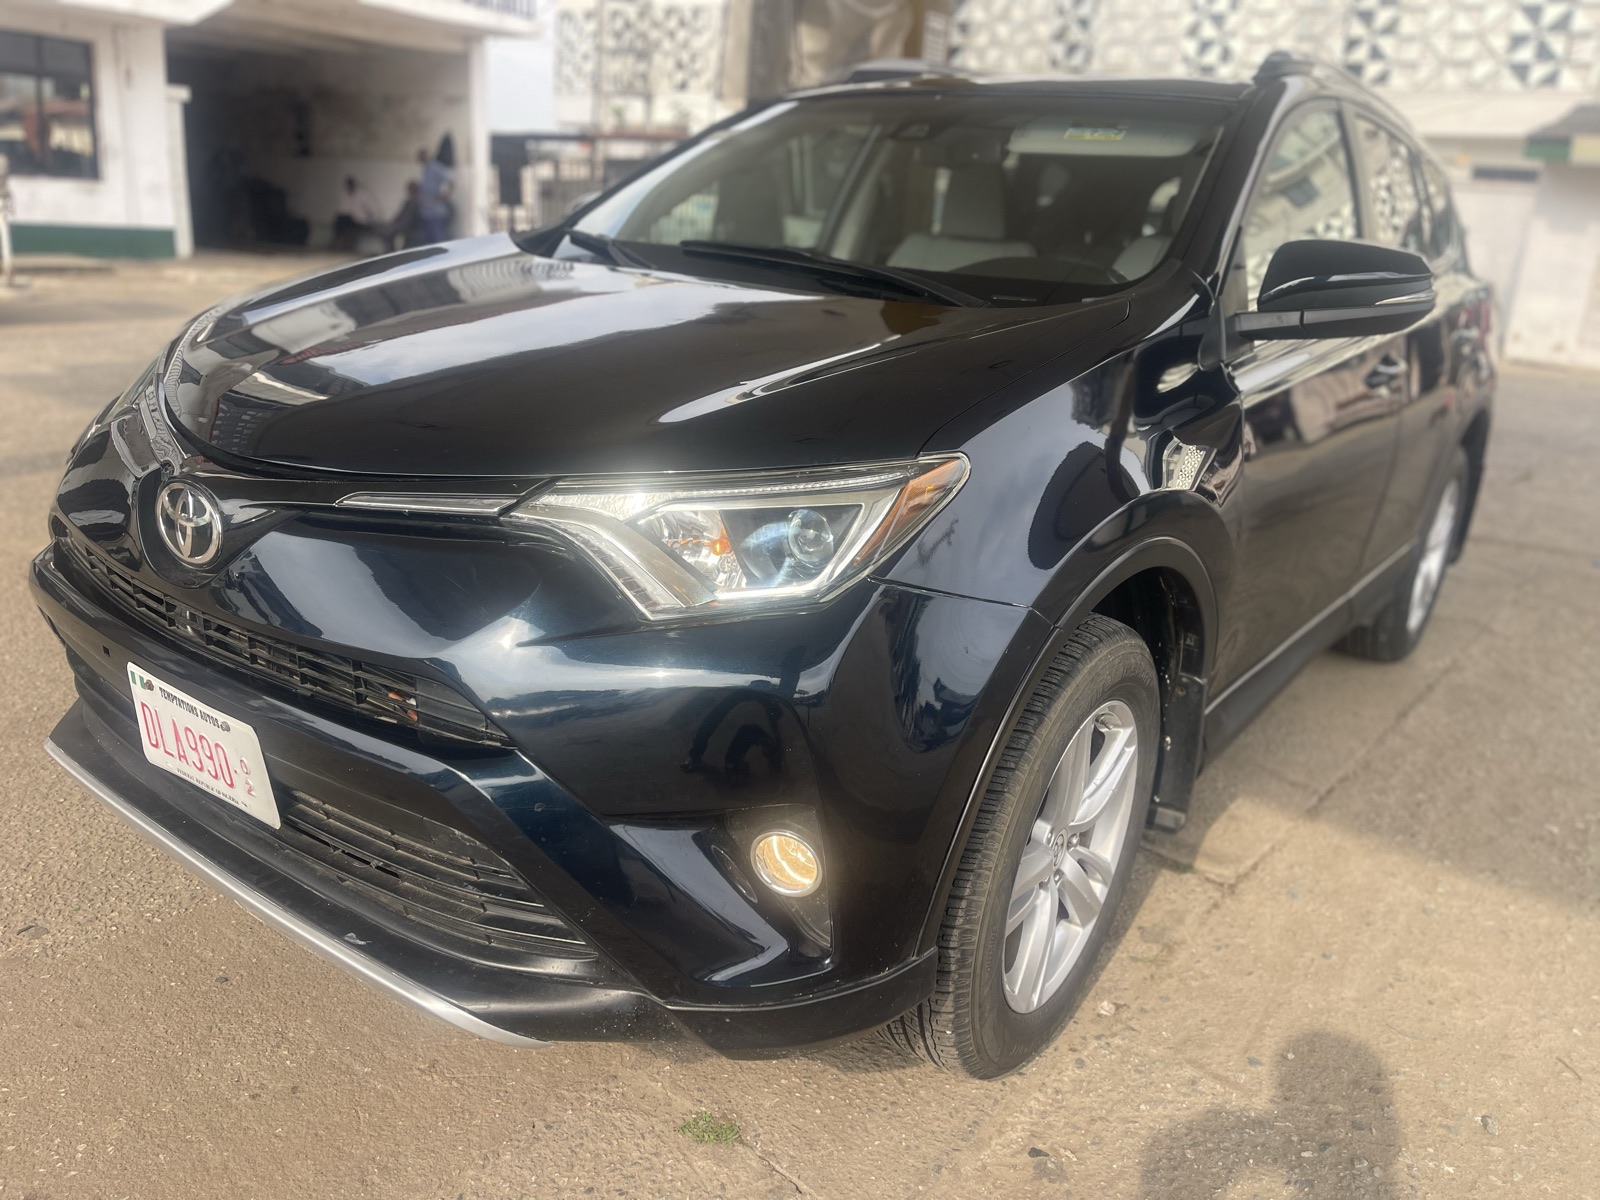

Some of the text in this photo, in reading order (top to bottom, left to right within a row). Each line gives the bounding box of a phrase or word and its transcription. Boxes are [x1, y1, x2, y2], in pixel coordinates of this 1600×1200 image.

[158, 686, 220, 729] TEMPTATIONS AUTOS
[140, 701, 235, 789] DLA990
